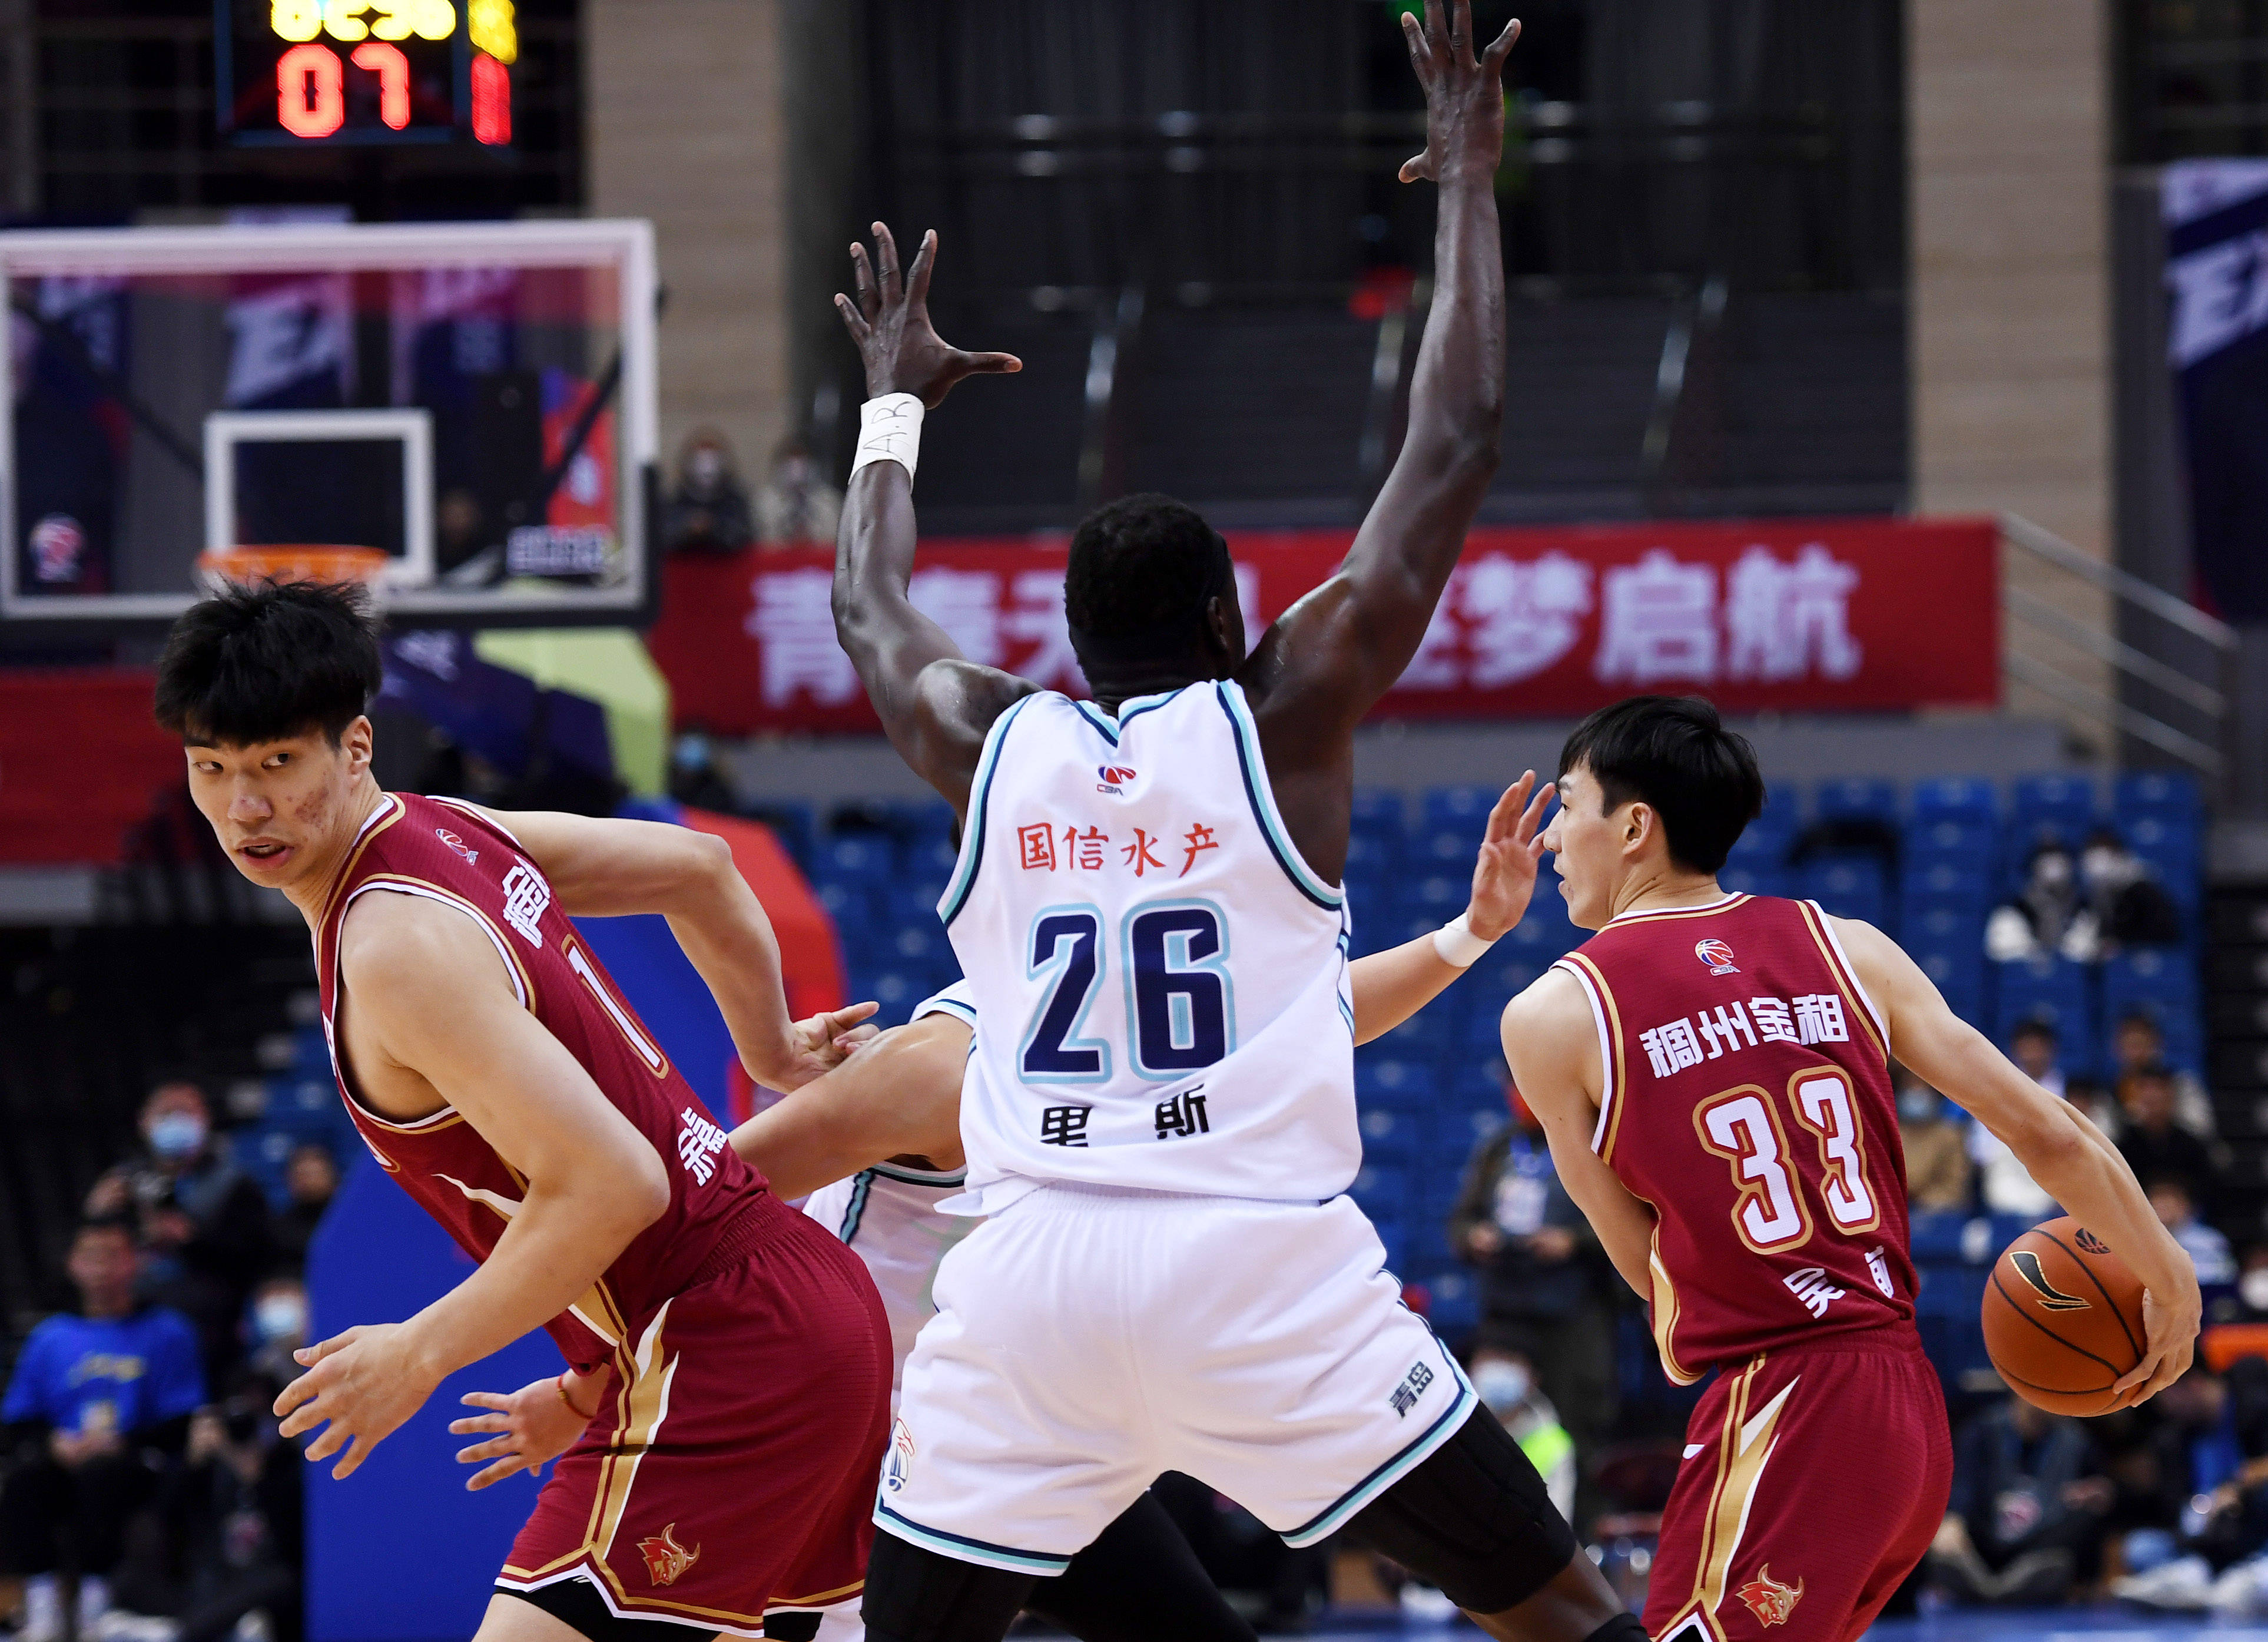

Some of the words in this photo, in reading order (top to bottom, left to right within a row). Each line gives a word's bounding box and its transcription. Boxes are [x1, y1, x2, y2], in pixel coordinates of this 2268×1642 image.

[277, 43, 411, 137] 07
[1017, 822, 1219, 878] 国信水产
[1016, 898, 1237, 1084] 26
[1639, 994, 1849, 1079] 稠州金租
[1040, 1083, 1210, 1148] 里斯
[1692, 1065, 1881, 1255] 33
[1390, 1361, 1434, 1418] 青岛
